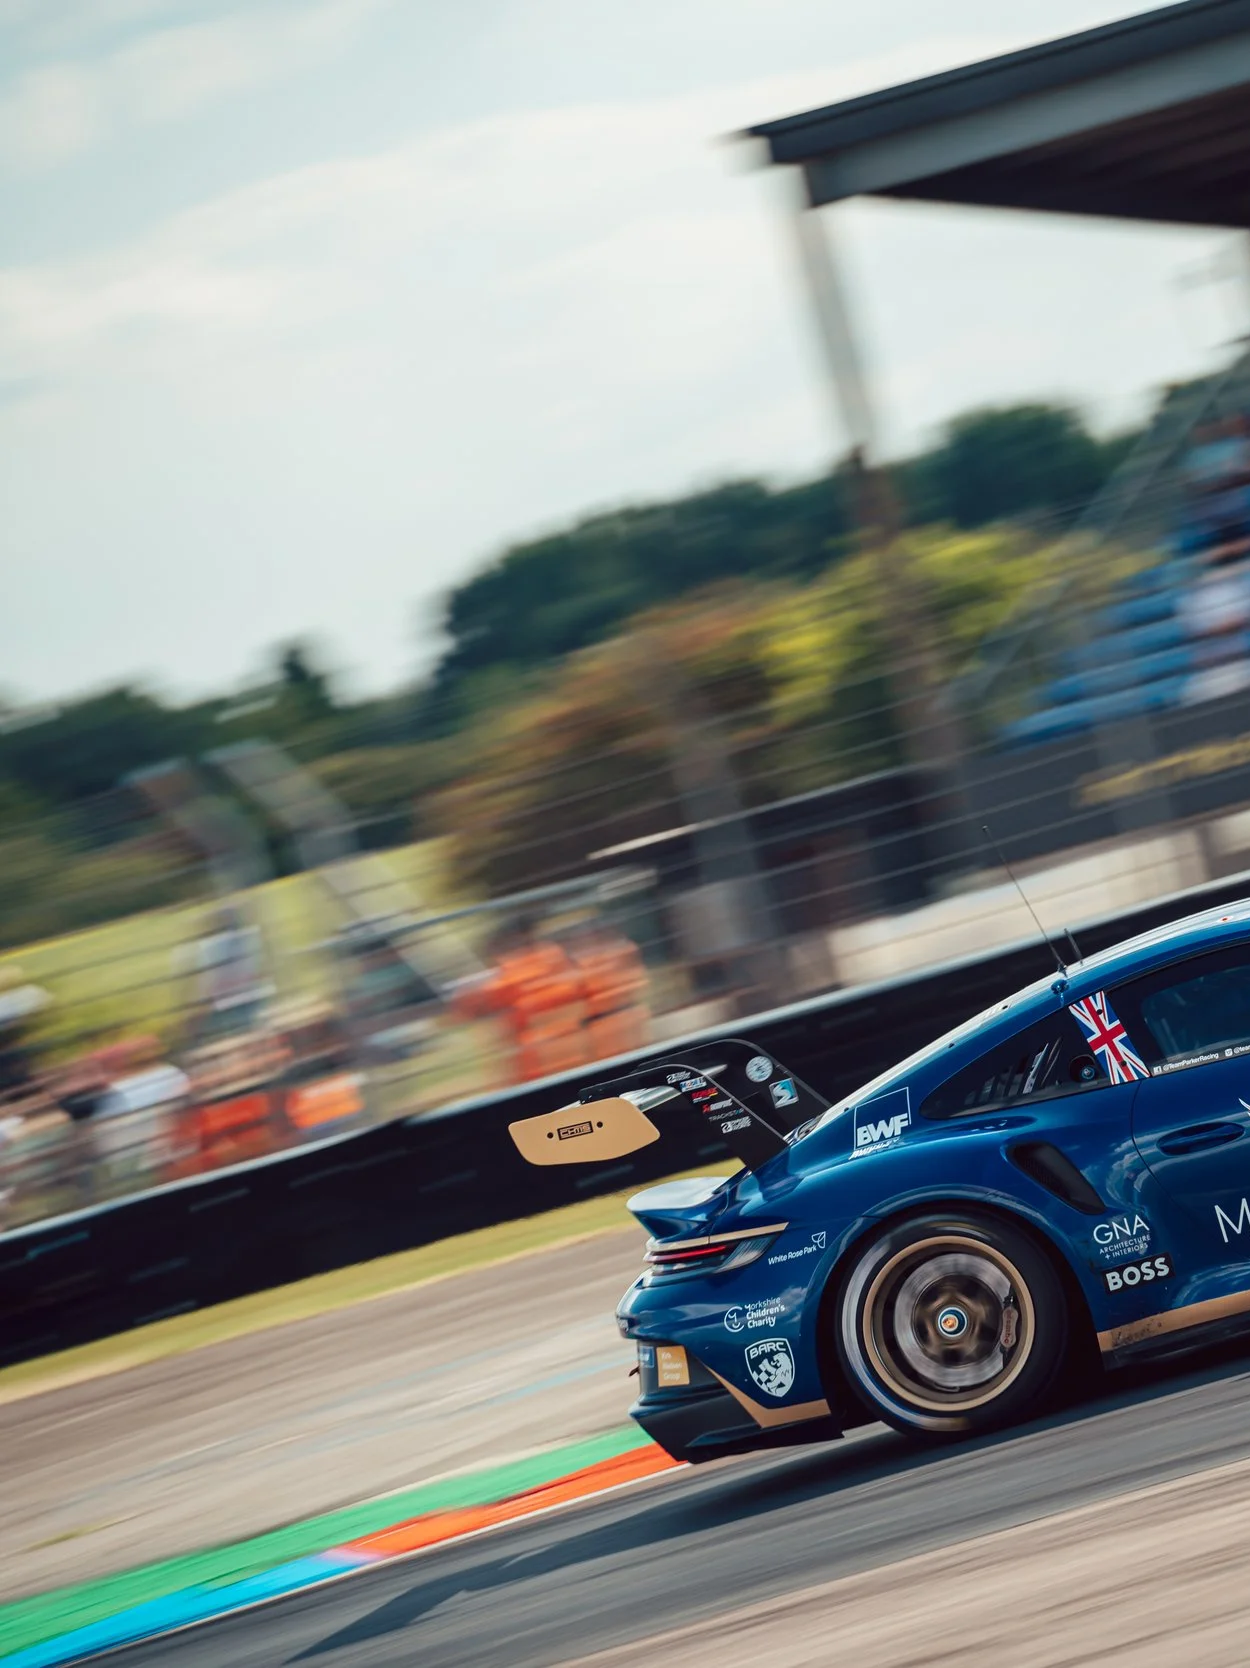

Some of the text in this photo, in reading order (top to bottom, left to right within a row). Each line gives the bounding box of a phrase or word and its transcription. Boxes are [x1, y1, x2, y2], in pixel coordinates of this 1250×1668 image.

[856, 1113, 909, 1148] BWF
[1093, 1214, 1150, 1244] GNA
[1099, 1233, 1151, 1255] ARCHITECTURE
[1112, 1242, 1149, 1259] INTERIORS
[768, 1244, 817, 1265] White Rose Park
[1105, 1257, 1170, 1291] BOSS
[744, 1296, 781, 1311] Yorkshire
[746, 1303, 786, 1320] Children's
[747, 1316, 776, 1329] Charity
[749, 1341, 787, 1360] BARC
